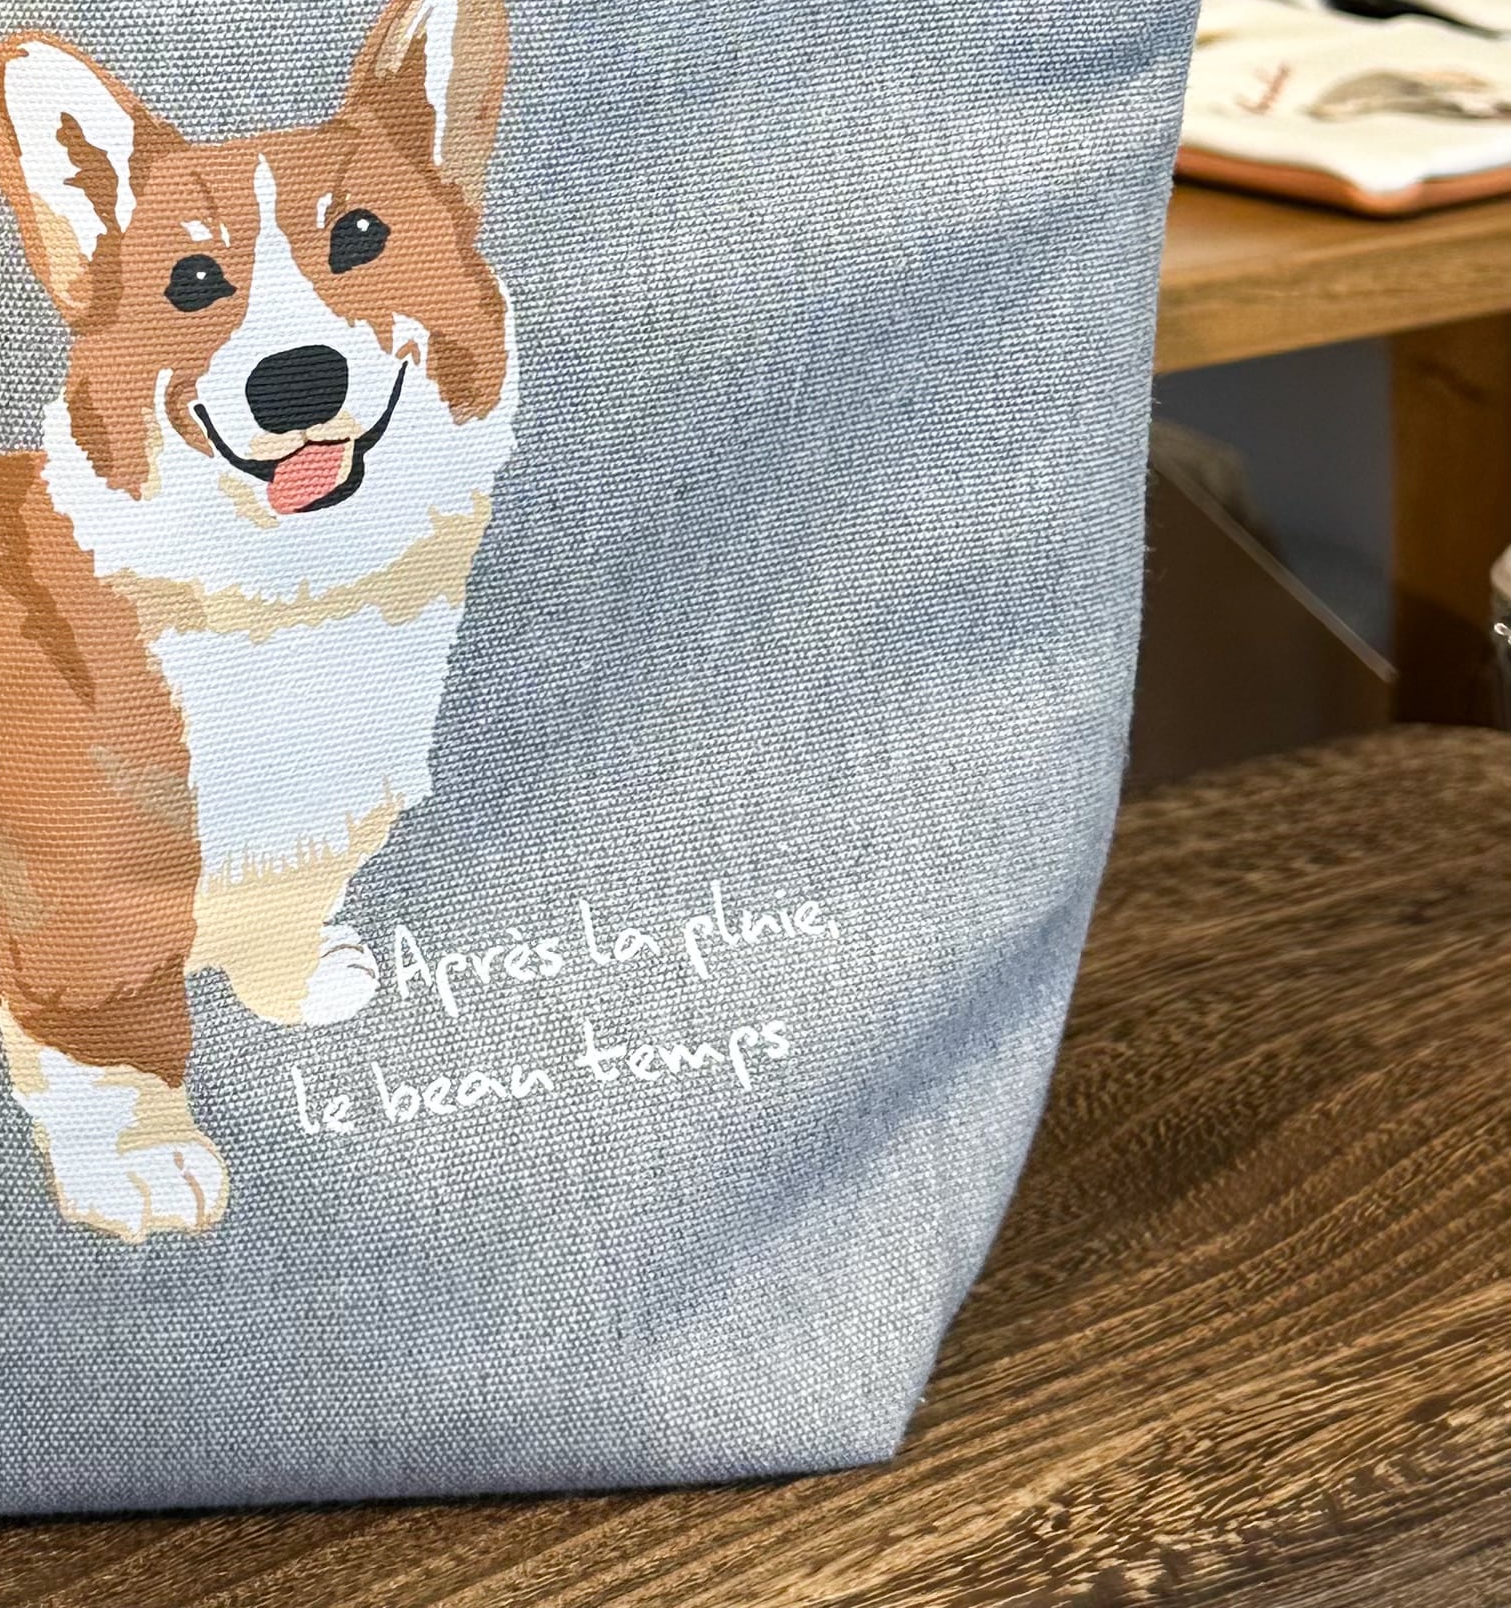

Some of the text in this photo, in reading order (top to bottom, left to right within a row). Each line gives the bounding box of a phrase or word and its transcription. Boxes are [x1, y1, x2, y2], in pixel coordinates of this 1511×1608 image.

[394, 924, 563, 1017] Après
[579, 899, 661, 965] la
[289, 1065, 355, 1134] le
[574, 1019, 789, 1091] temps
